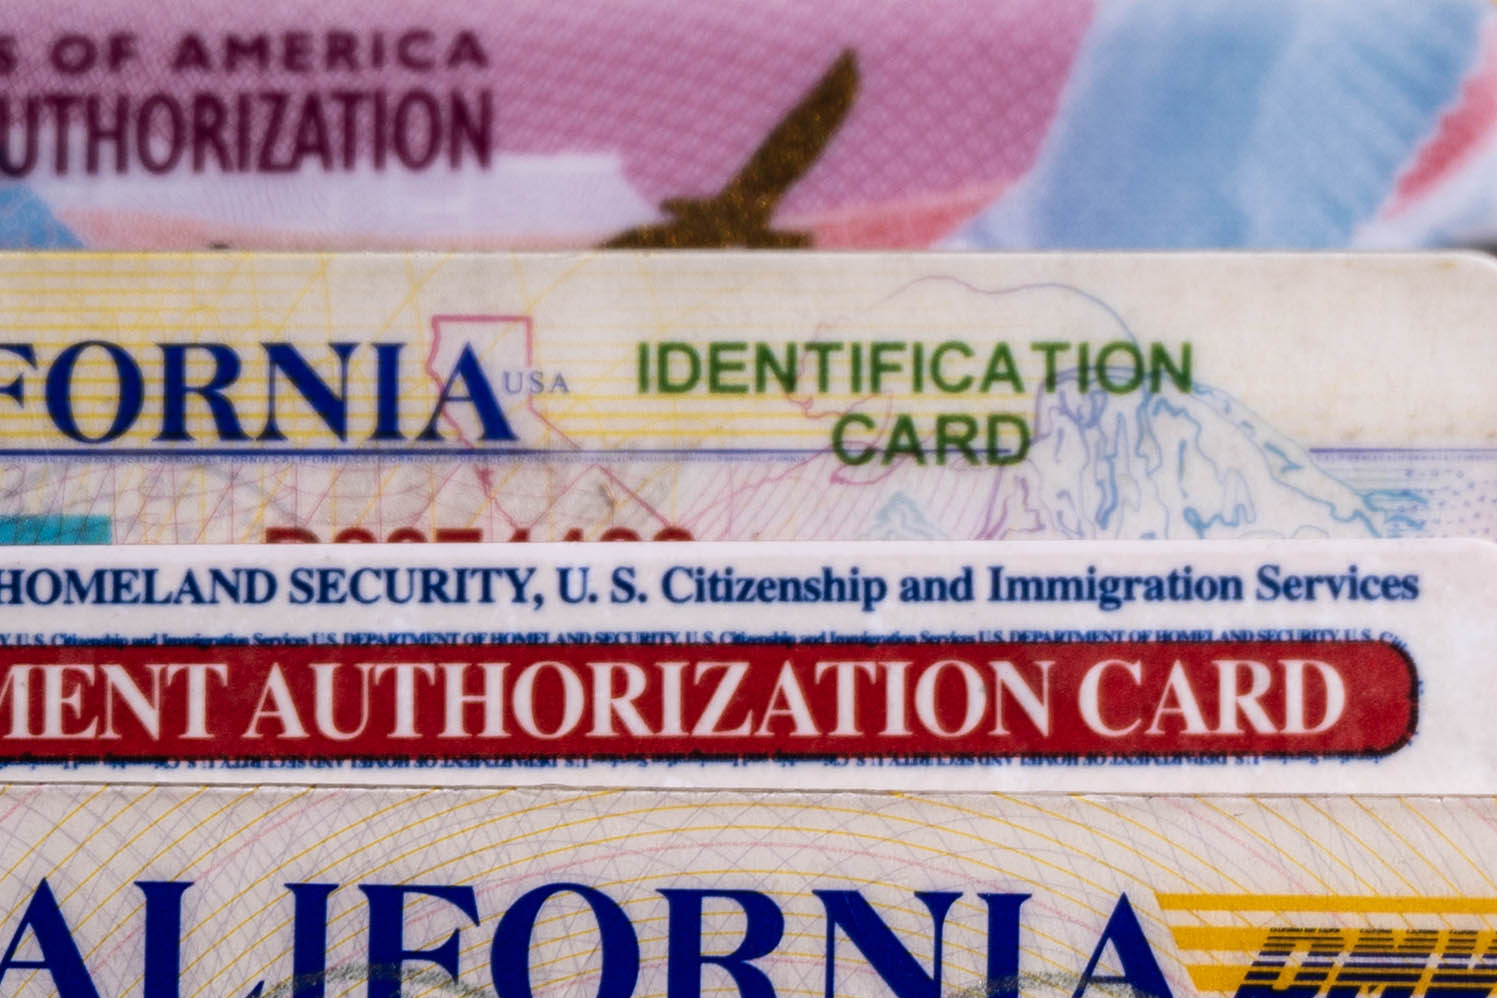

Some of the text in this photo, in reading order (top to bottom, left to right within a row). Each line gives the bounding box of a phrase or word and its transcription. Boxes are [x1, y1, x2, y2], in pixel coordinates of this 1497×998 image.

[51, 32, 137, 74] OF
[171, 29, 489, 73] AMERICA
[502, 369, 571, 396] USA
[636, 340, 1194, 396] IDENTIFICATION
[831, 412, 1032, 467] CARD
[288, 566, 544, 612] SECURITY,
[556, 567, 598, 604] U.
[611, 566, 648, 604] S.
[661, 564, 887, 612] Citizenship
[900, 565, 974, 603] and
[987, 564, 1244, 611] Immigration
[1256, 564, 1421, 602] Services
[242, 658, 1056, 741] AUTHORIZATION
[1078, 657, 1347, 738] CARD
